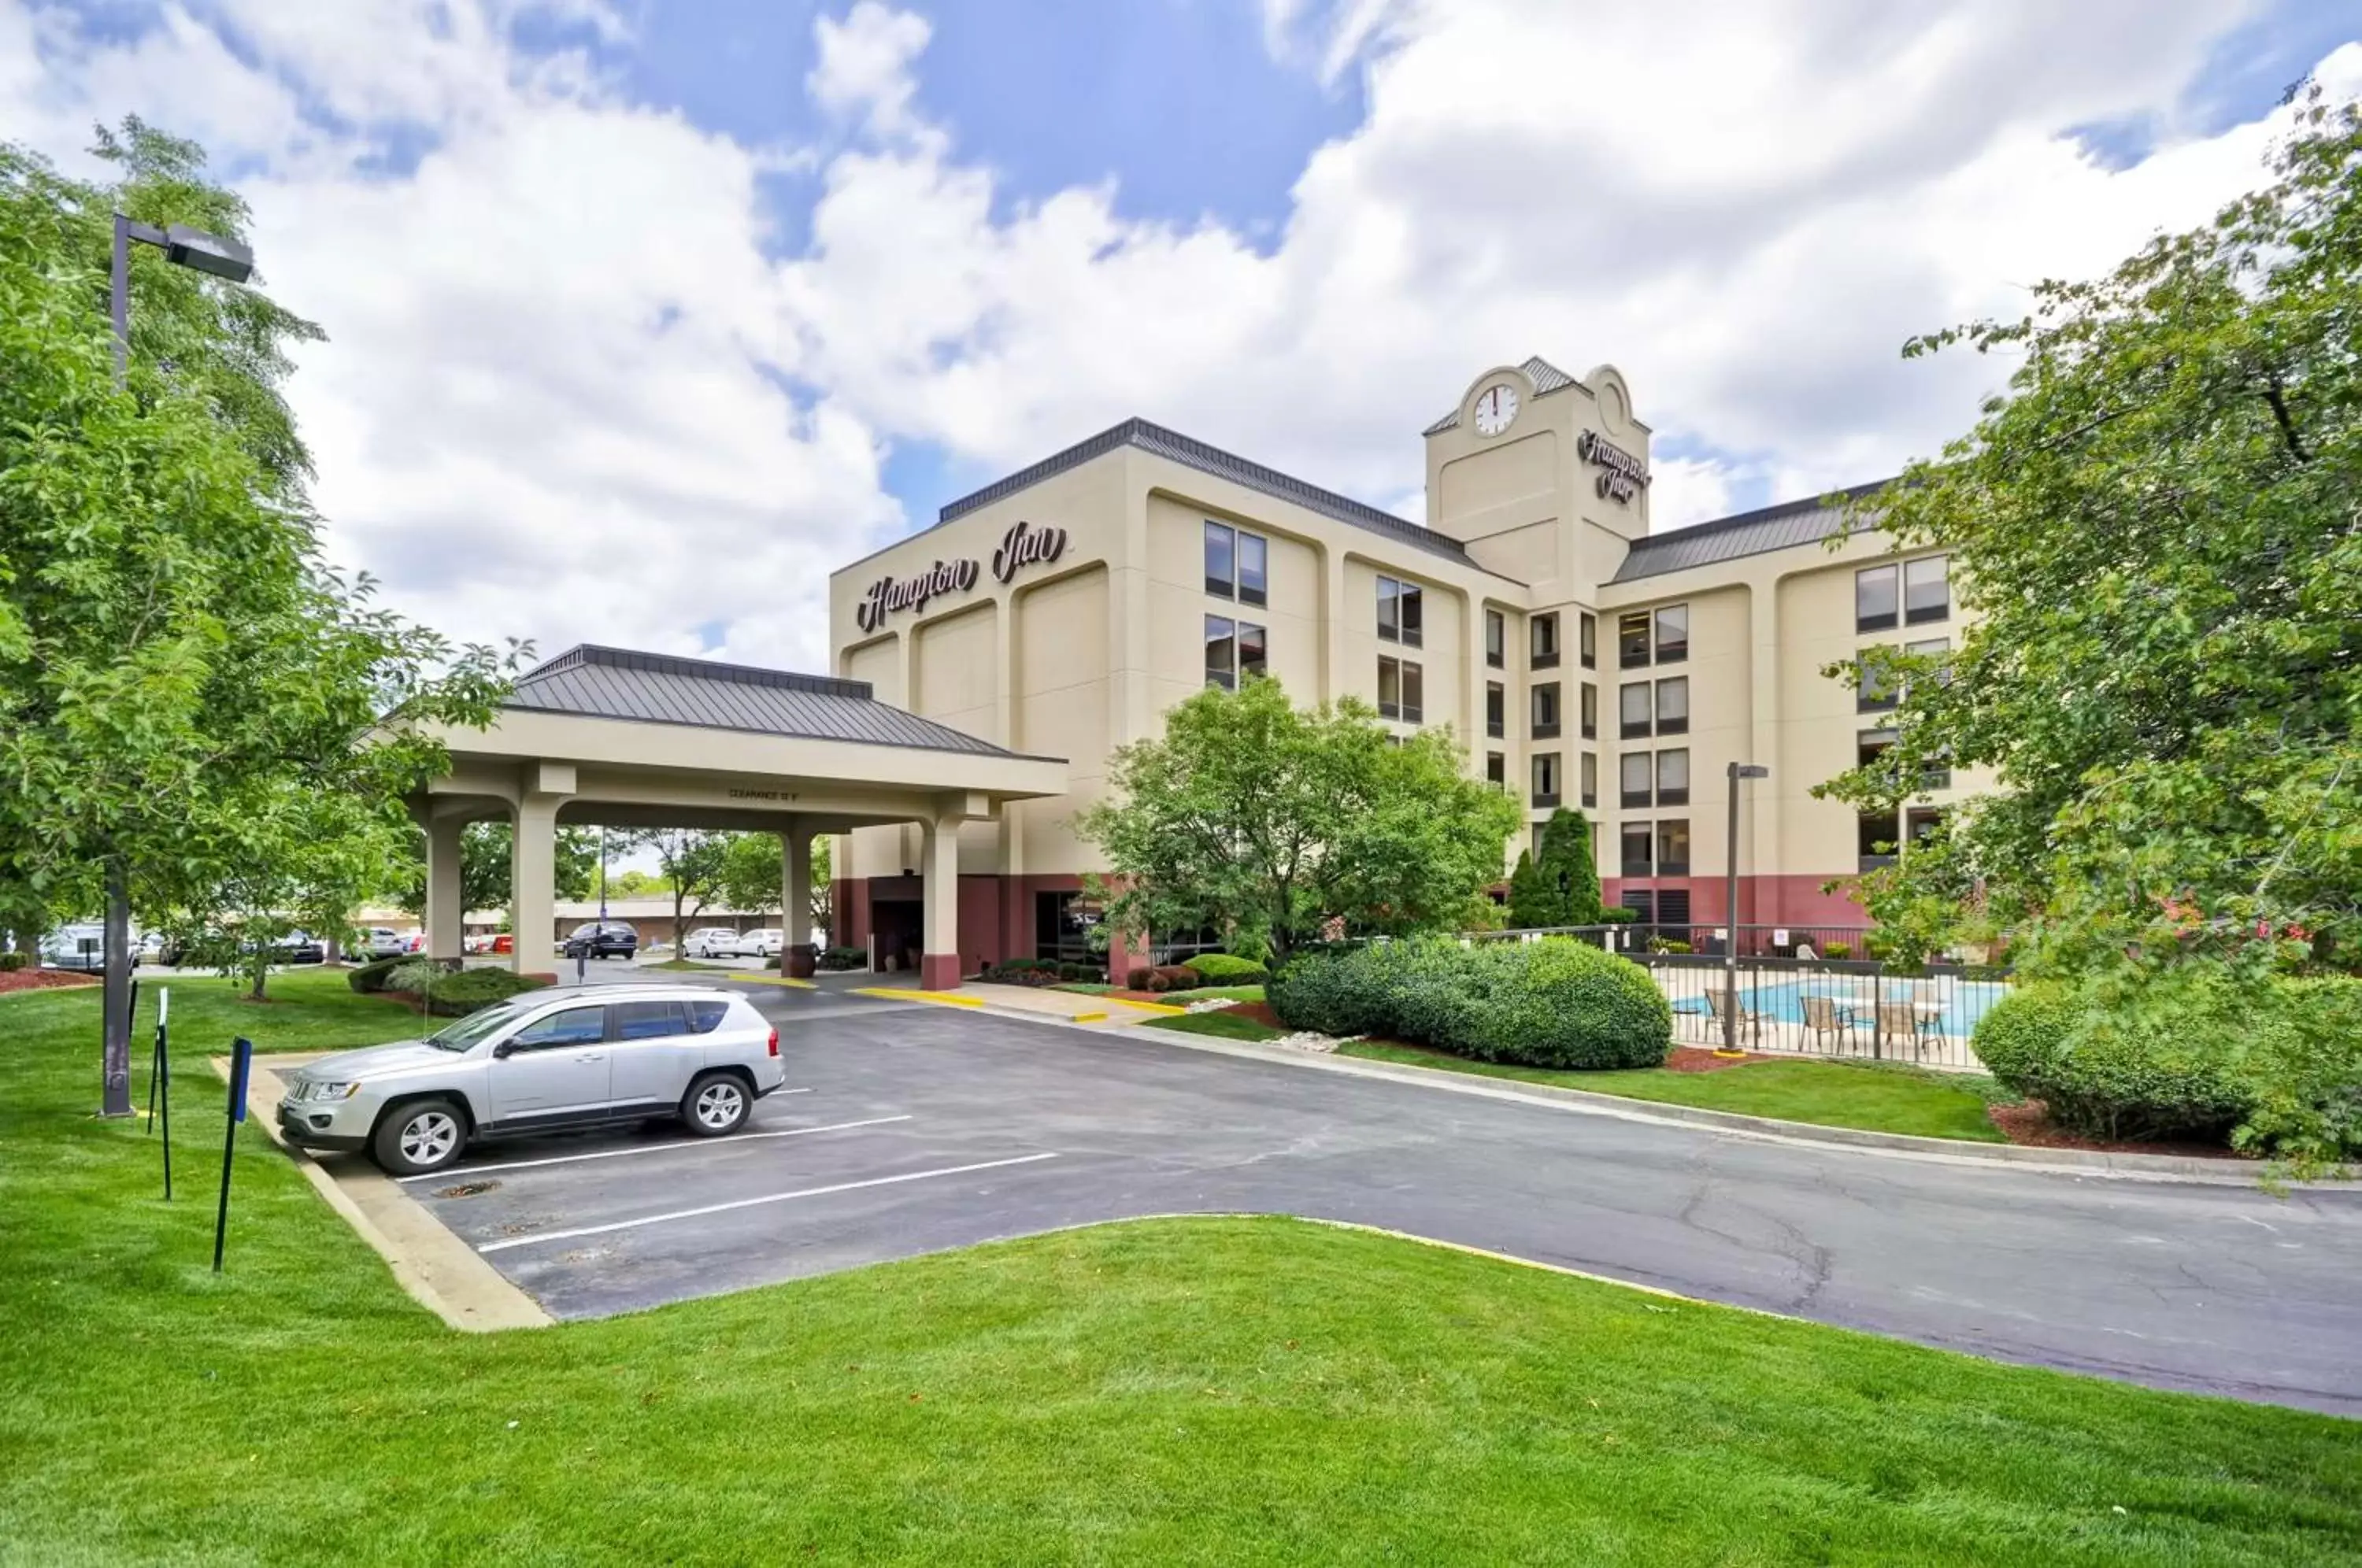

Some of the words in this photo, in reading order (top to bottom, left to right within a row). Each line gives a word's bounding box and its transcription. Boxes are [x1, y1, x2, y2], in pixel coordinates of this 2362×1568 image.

[1578, 428, 1653, 489] Hampton
[1595, 469, 1633, 504] Inn
[857, 559, 980, 632] Hampton
[992, 521, 1068, 583] Inn
